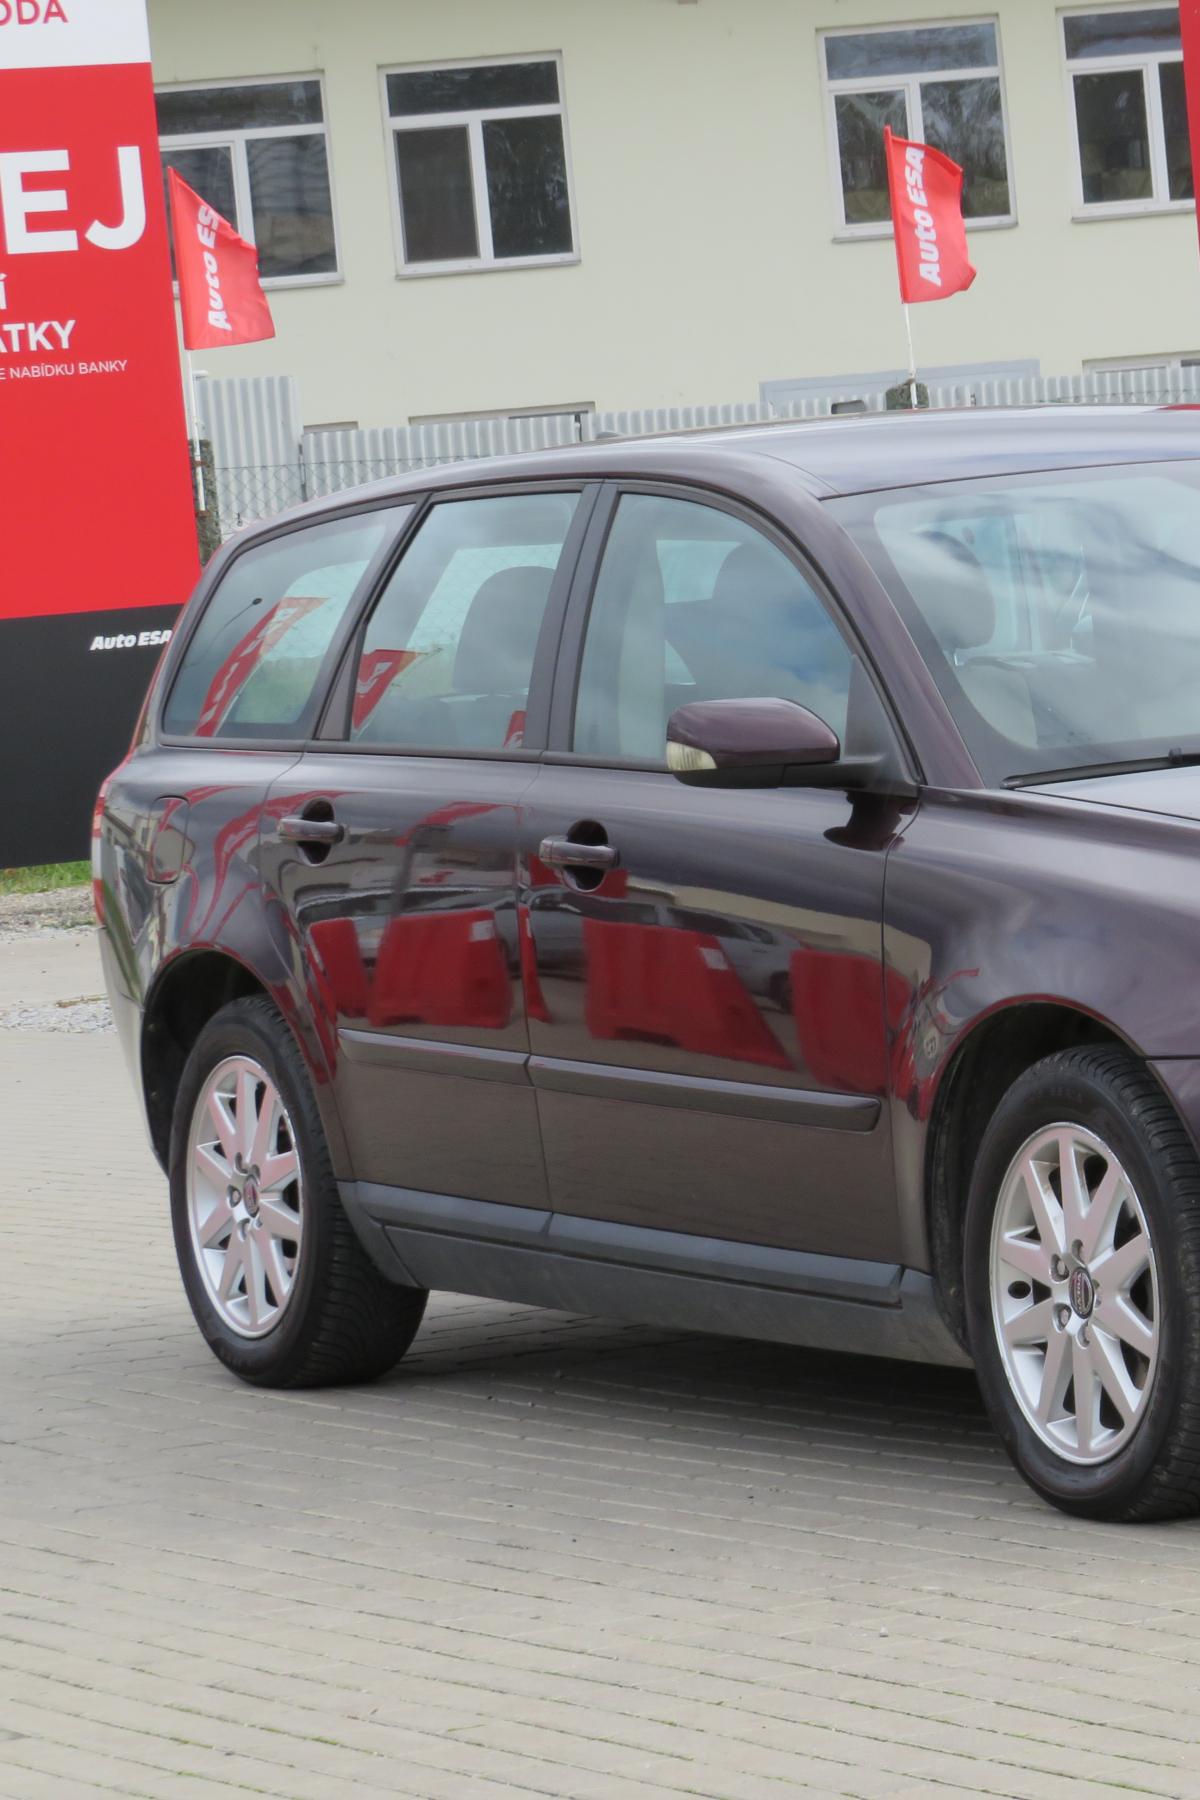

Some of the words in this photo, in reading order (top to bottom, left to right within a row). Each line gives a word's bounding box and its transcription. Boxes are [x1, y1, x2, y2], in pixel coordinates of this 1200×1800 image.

[905, 147, 928, 206] ESA
[914, 209, 942, 287] Auto
[203, 251, 232, 331] Auto
[0, 320, 76, 353] TKY
[10, 363, 74, 379] NABÍDKU
[79, 360, 128, 374] BANKY
[90, 634, 137, 650] Auto
[137, 630, 173, 646] ESA
